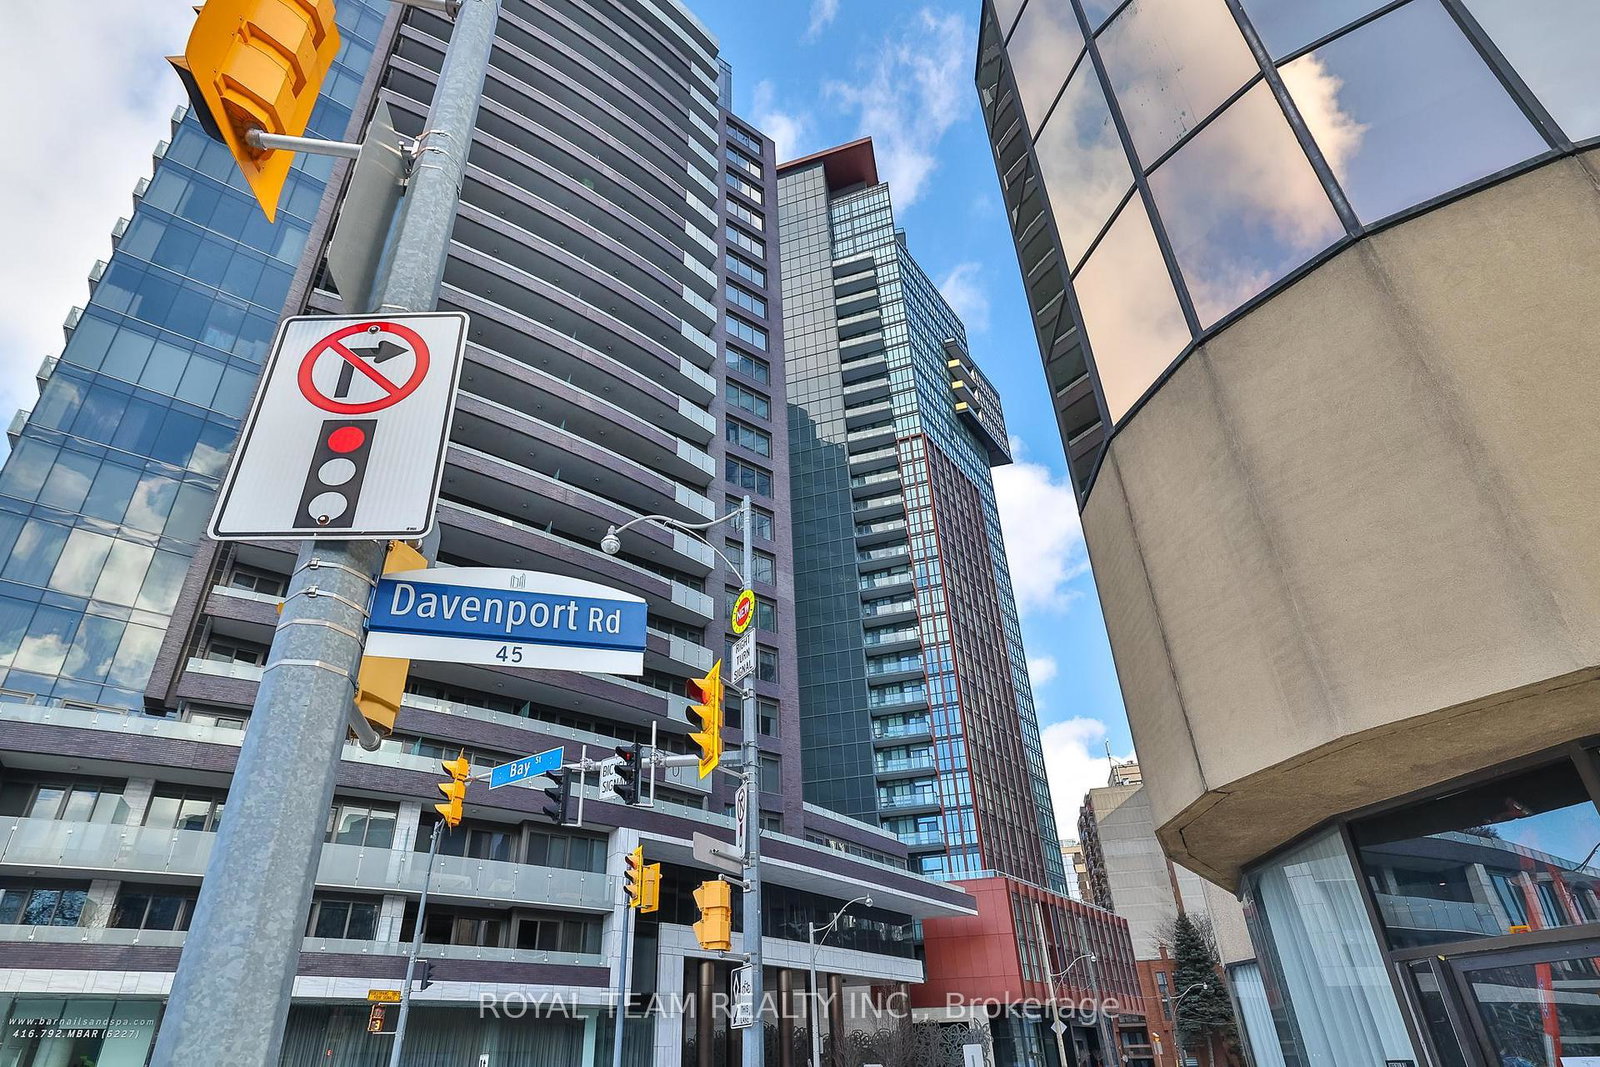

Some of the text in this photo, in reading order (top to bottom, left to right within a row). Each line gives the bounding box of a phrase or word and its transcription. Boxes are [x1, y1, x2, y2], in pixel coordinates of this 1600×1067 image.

[390, 583, 621, 634] Davenport Rd
[735, 635, 750, 654] RIGHT
[496, 645, 523, 663] 45
[736, 648, 750, 666] TURN
[734, 660, 752, 680] SIGNAL
[510, 756, 542, 778] Bay St
[8, 1017, 155, 1027] www.barnailsandspa.com
[12, 1029, 140, 1039] 416.792.MBAR (6227)
